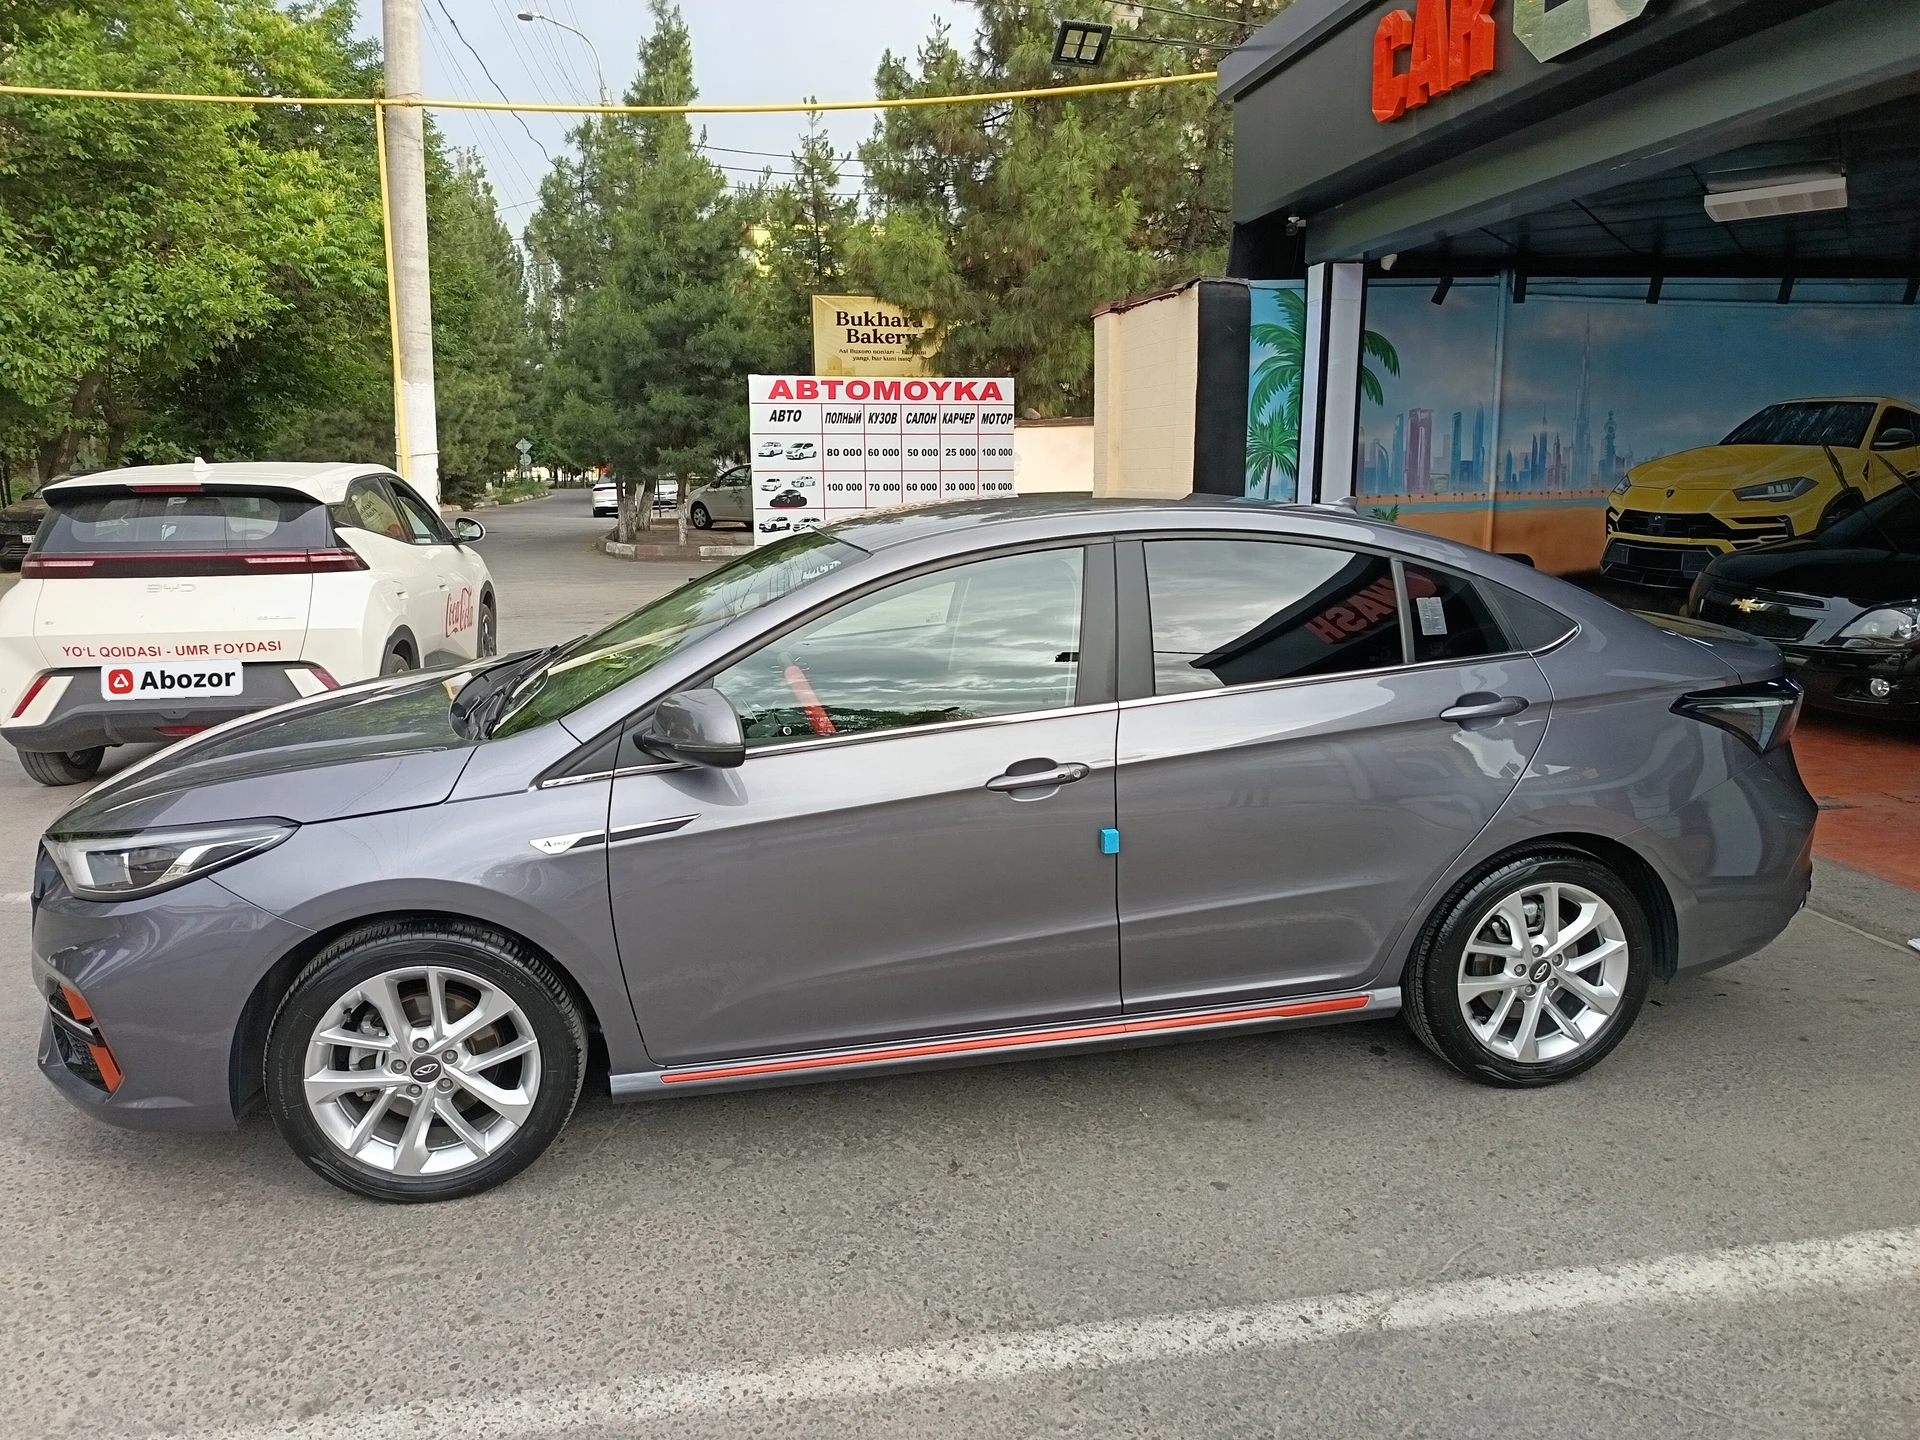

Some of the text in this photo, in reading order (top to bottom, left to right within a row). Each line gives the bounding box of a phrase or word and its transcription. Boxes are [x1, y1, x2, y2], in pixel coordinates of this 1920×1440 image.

[1372, 0, 1496, 122] CAR
[769, 409, 802, 422] АВТО
[825, 410, 862, 424] ПОЛНЫЙ
[868, 412, 898, 424] КУЗОВ
[906, 412, 937, 424] САЛОН
[942, 412, 975, 424] КАРЧЕР
[981, 412, 1013, 425] МОТОР
[826, 448, 862, 457] 80 000
[868, 448, 899, 457] 60 000
[907, 448, 938, 457] 50 000
[945, 448, 976, 457] 25 000
[982, 448, 1013, 456] 100 000
[826, 483, 862, 491] 100 000
[868, 483, 900, 491] 70 000
[906, 483, 938, 491] 60 000
[945, 483, 976, 491] 30 000
[981, 482, 1013, 490] 100 000
[99, 645, 162, 658] QOIDASI
[175, 644, 210, 656] UMR
[214, 640, 282, 655] FOYDASI
